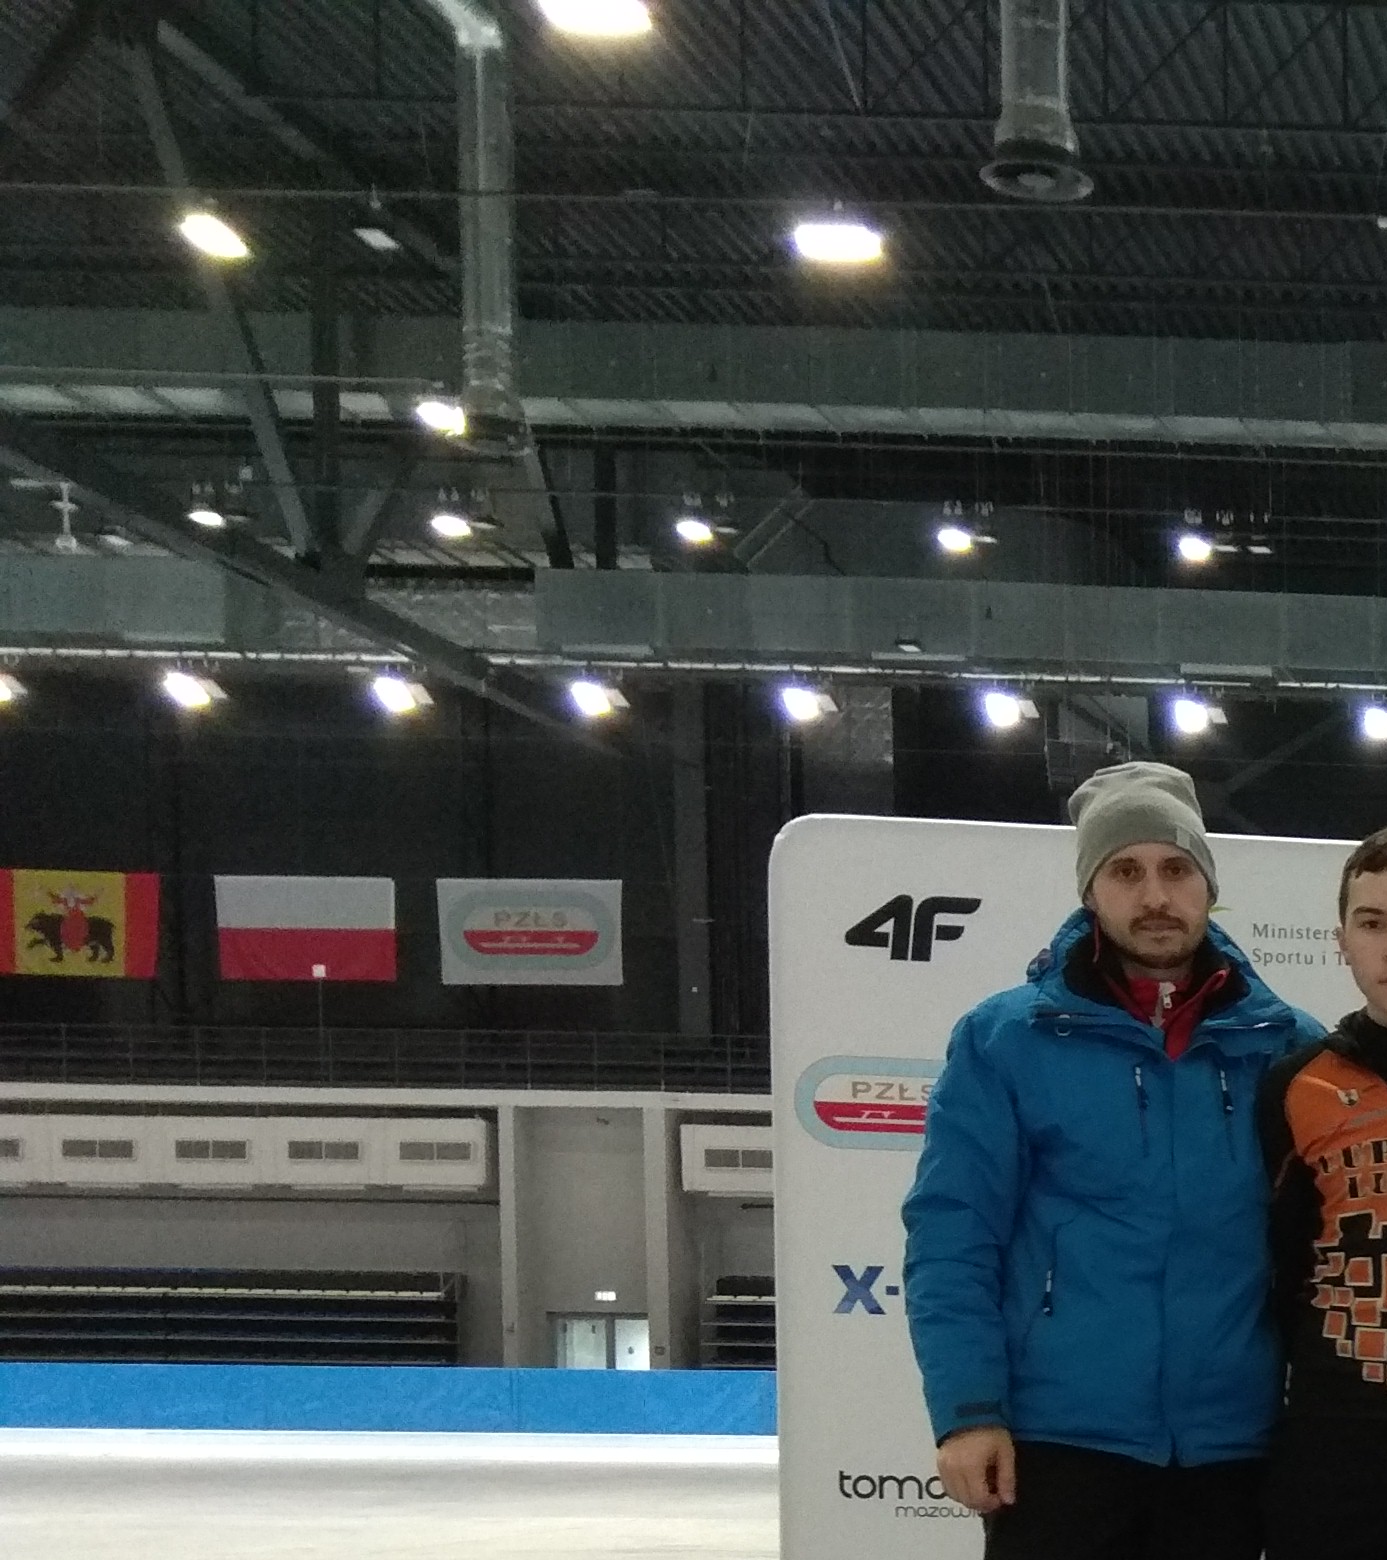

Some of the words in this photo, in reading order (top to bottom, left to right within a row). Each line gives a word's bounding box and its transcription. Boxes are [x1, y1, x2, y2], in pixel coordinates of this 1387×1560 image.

[845, 895, 982, 962] 4F
[1252, 923, 1342, 940] Ministers
[1252, 948, 1314, 966] Sportu
[839, 1470, 948, 1500] toma
[895, 1506, 978, 1518] mazowi
